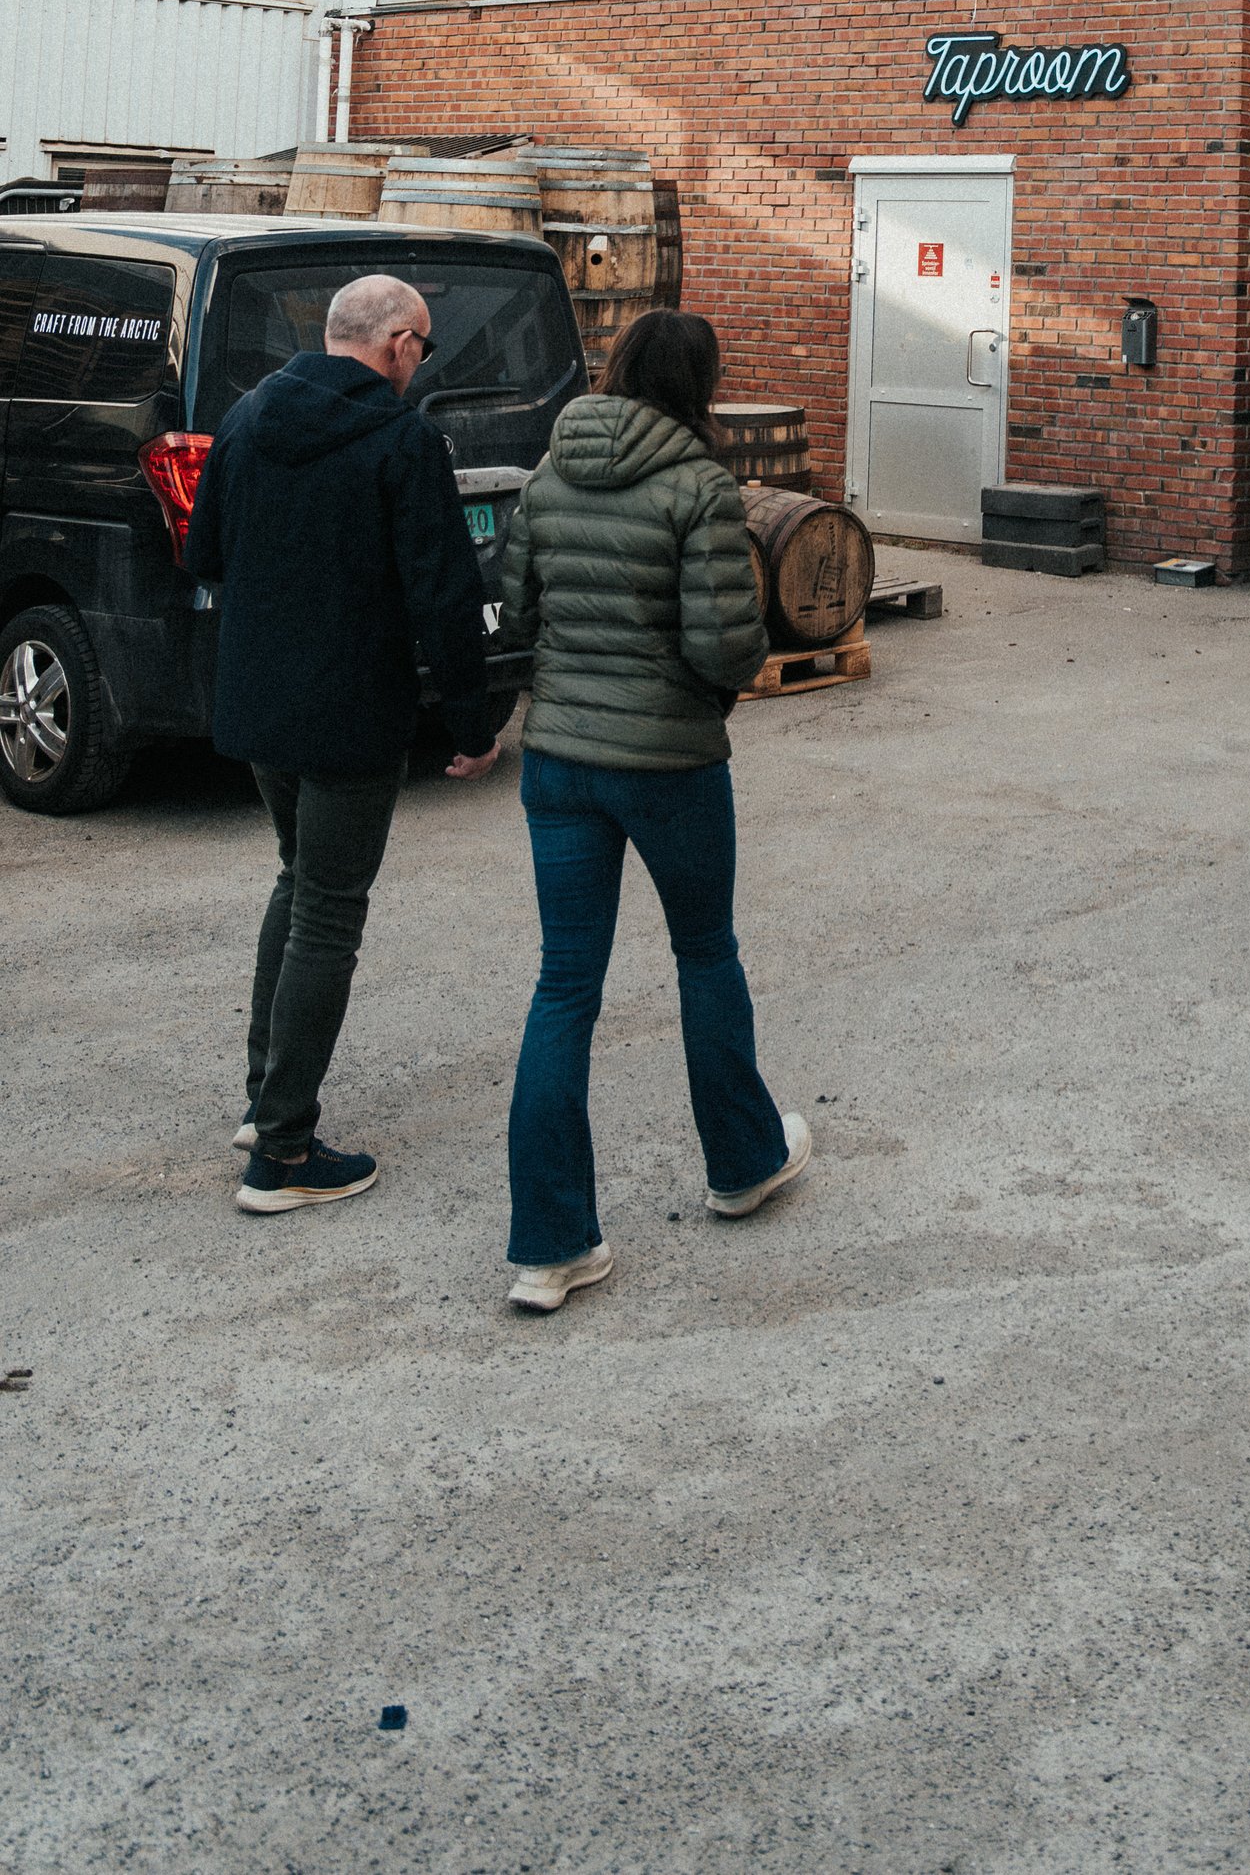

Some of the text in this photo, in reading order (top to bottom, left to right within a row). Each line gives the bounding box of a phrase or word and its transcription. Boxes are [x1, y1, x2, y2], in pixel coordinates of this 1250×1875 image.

[924, 35, 1126, 121] Taproom
[33, 313, 161, 341] CRAFT FROM THE ARCTIC
